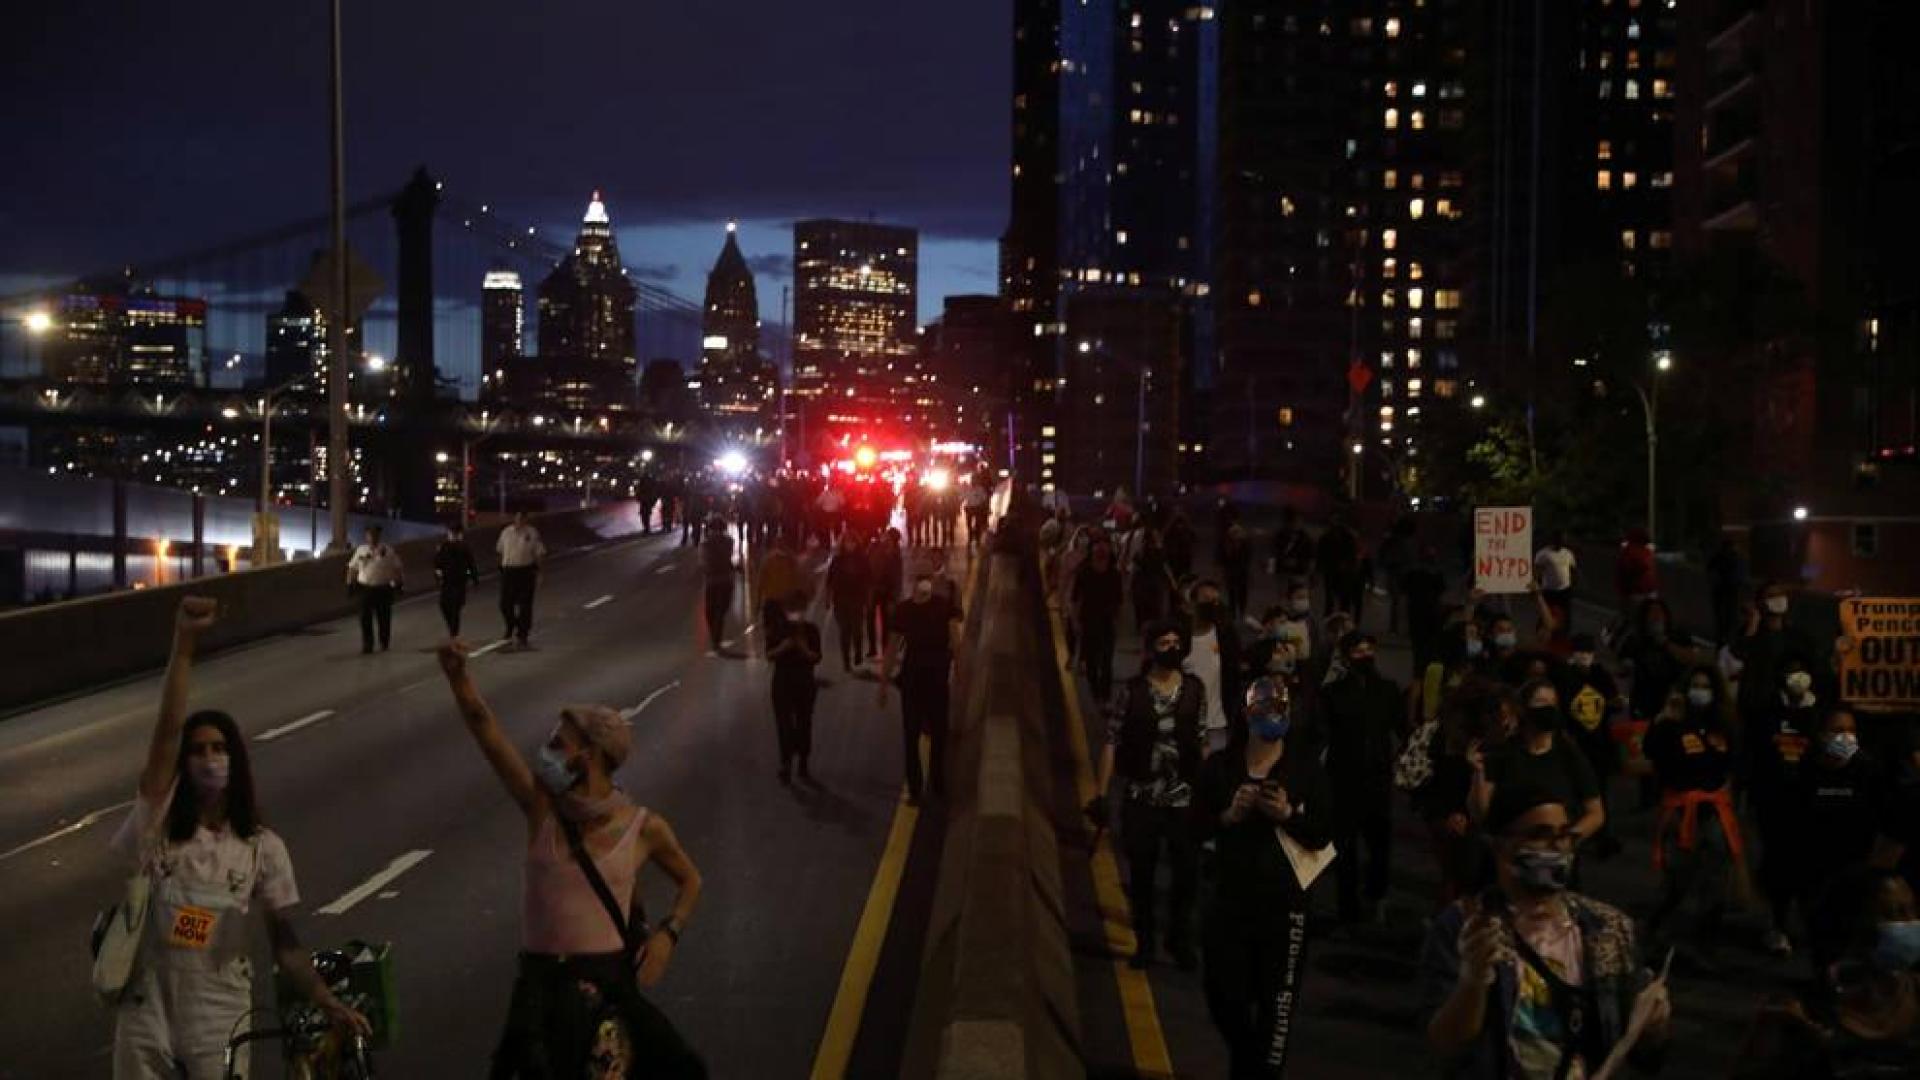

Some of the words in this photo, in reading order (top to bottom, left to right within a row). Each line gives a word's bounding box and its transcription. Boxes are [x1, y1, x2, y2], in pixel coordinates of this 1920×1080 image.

[1477, 511, 1526, 535] END
[1479, 557, 1528, 577] NYPD
[179, 914, 211, 931] OUT
[173, 926, 208, 943] NOW
